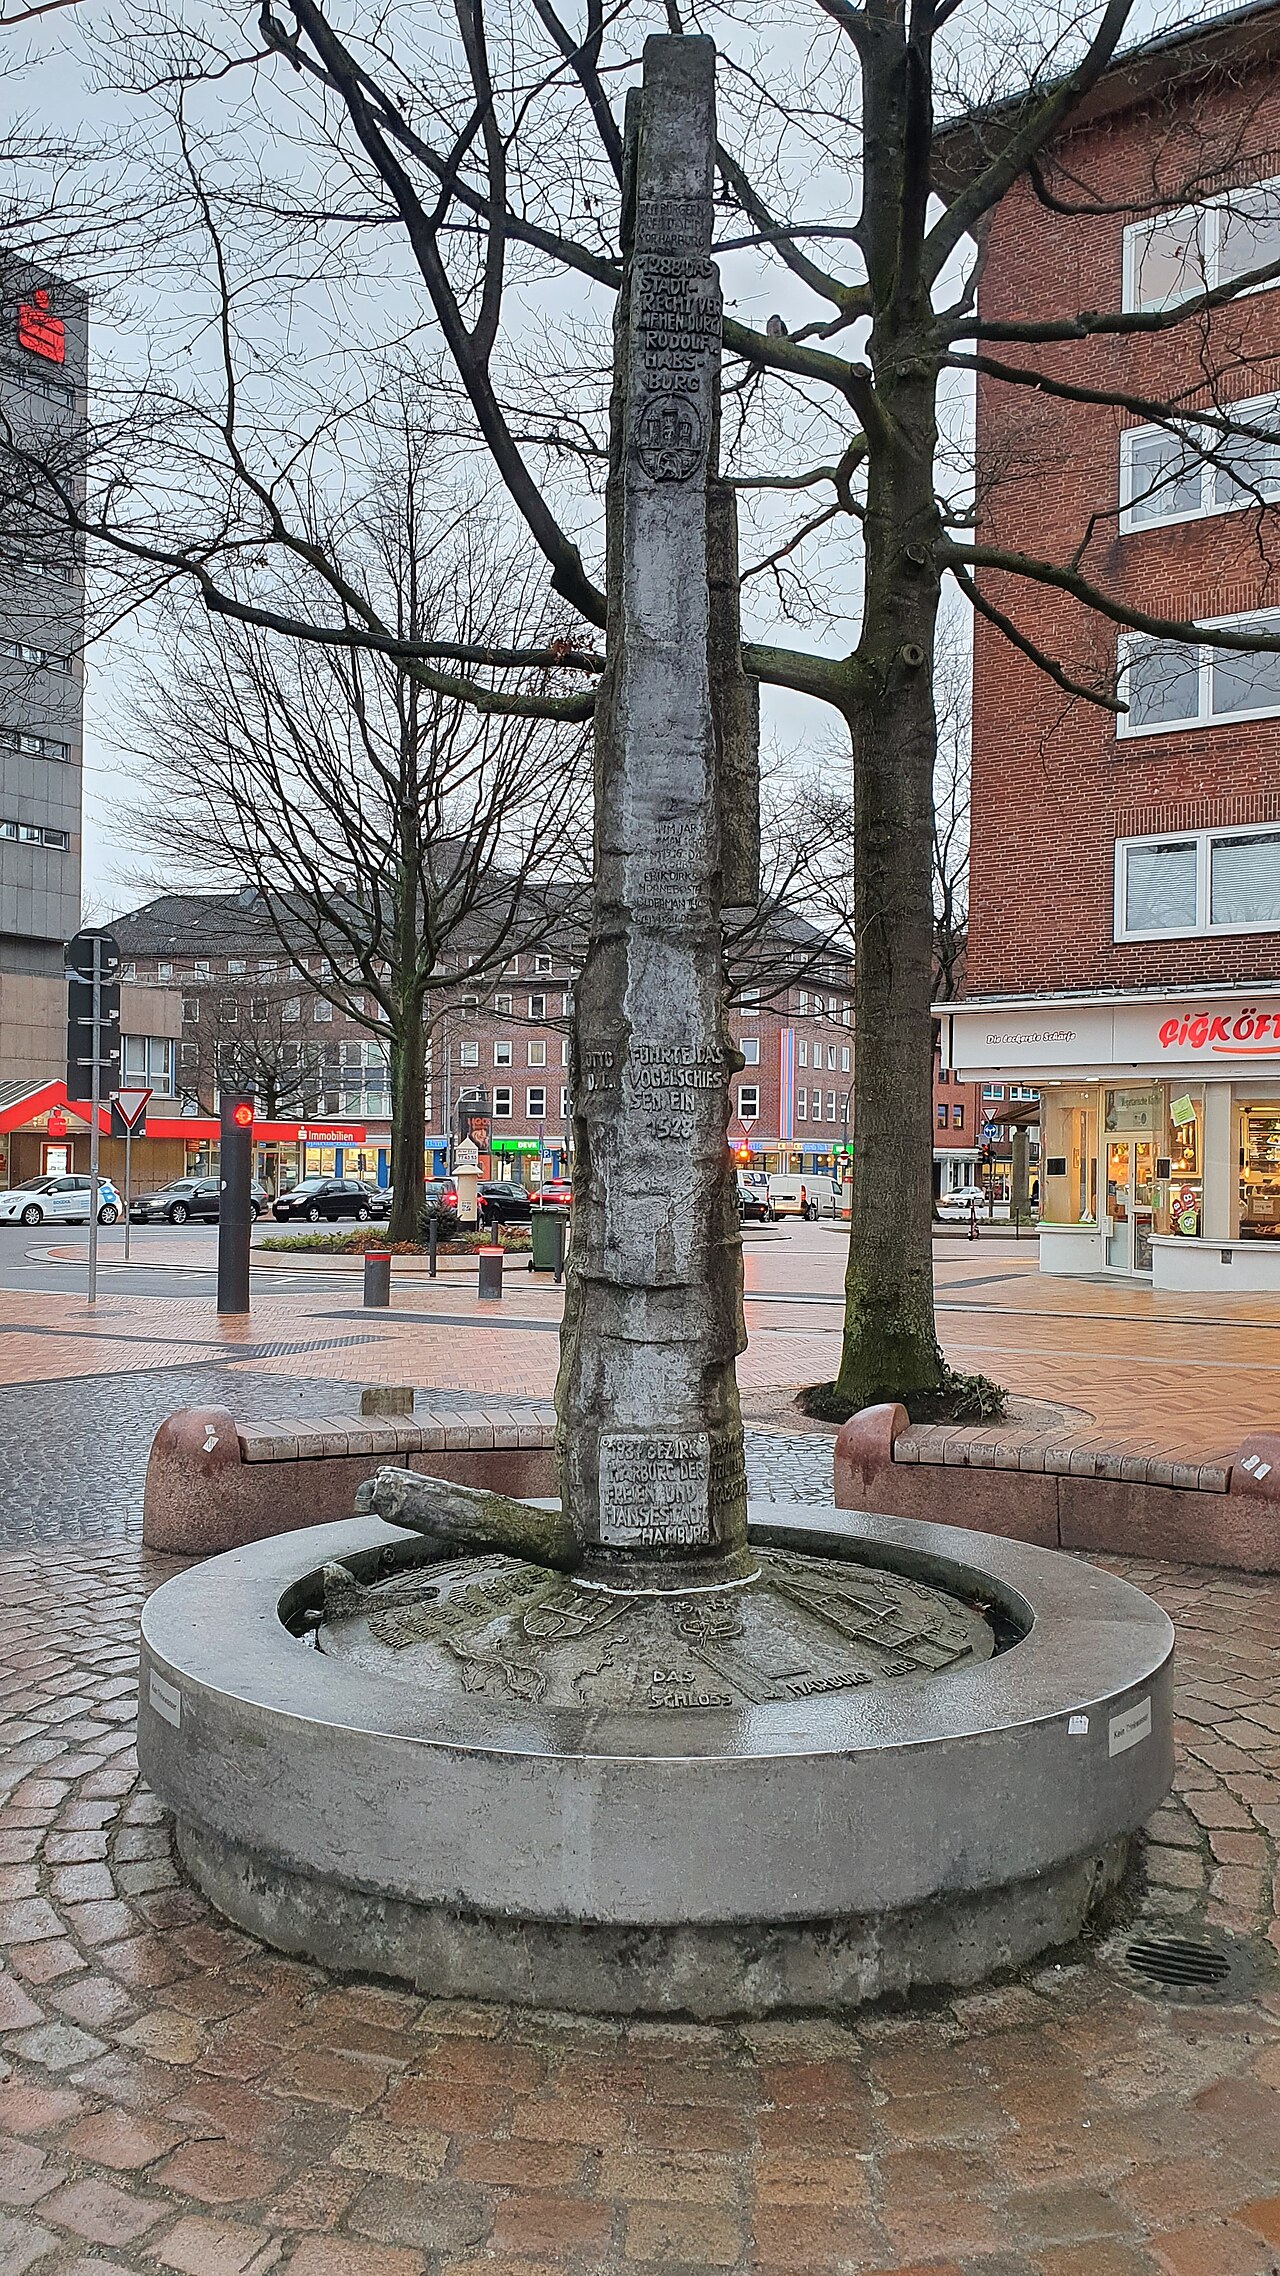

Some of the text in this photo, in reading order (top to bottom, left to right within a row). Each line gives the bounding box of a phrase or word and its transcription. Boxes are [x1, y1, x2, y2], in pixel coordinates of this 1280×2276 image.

[645, 371, 700, 393] BURG
[308, 1130, 354, 1141] Immobilien
[517, 1141, 538, 1149] DEVK
[641, 1525, 711, 1546] HAMBURG
[652, 1670, 697, 1685] DAS
[785, 1670, 873, 1699] HARBURG
[649, 1692, 733, 1709] SCHLOSS
